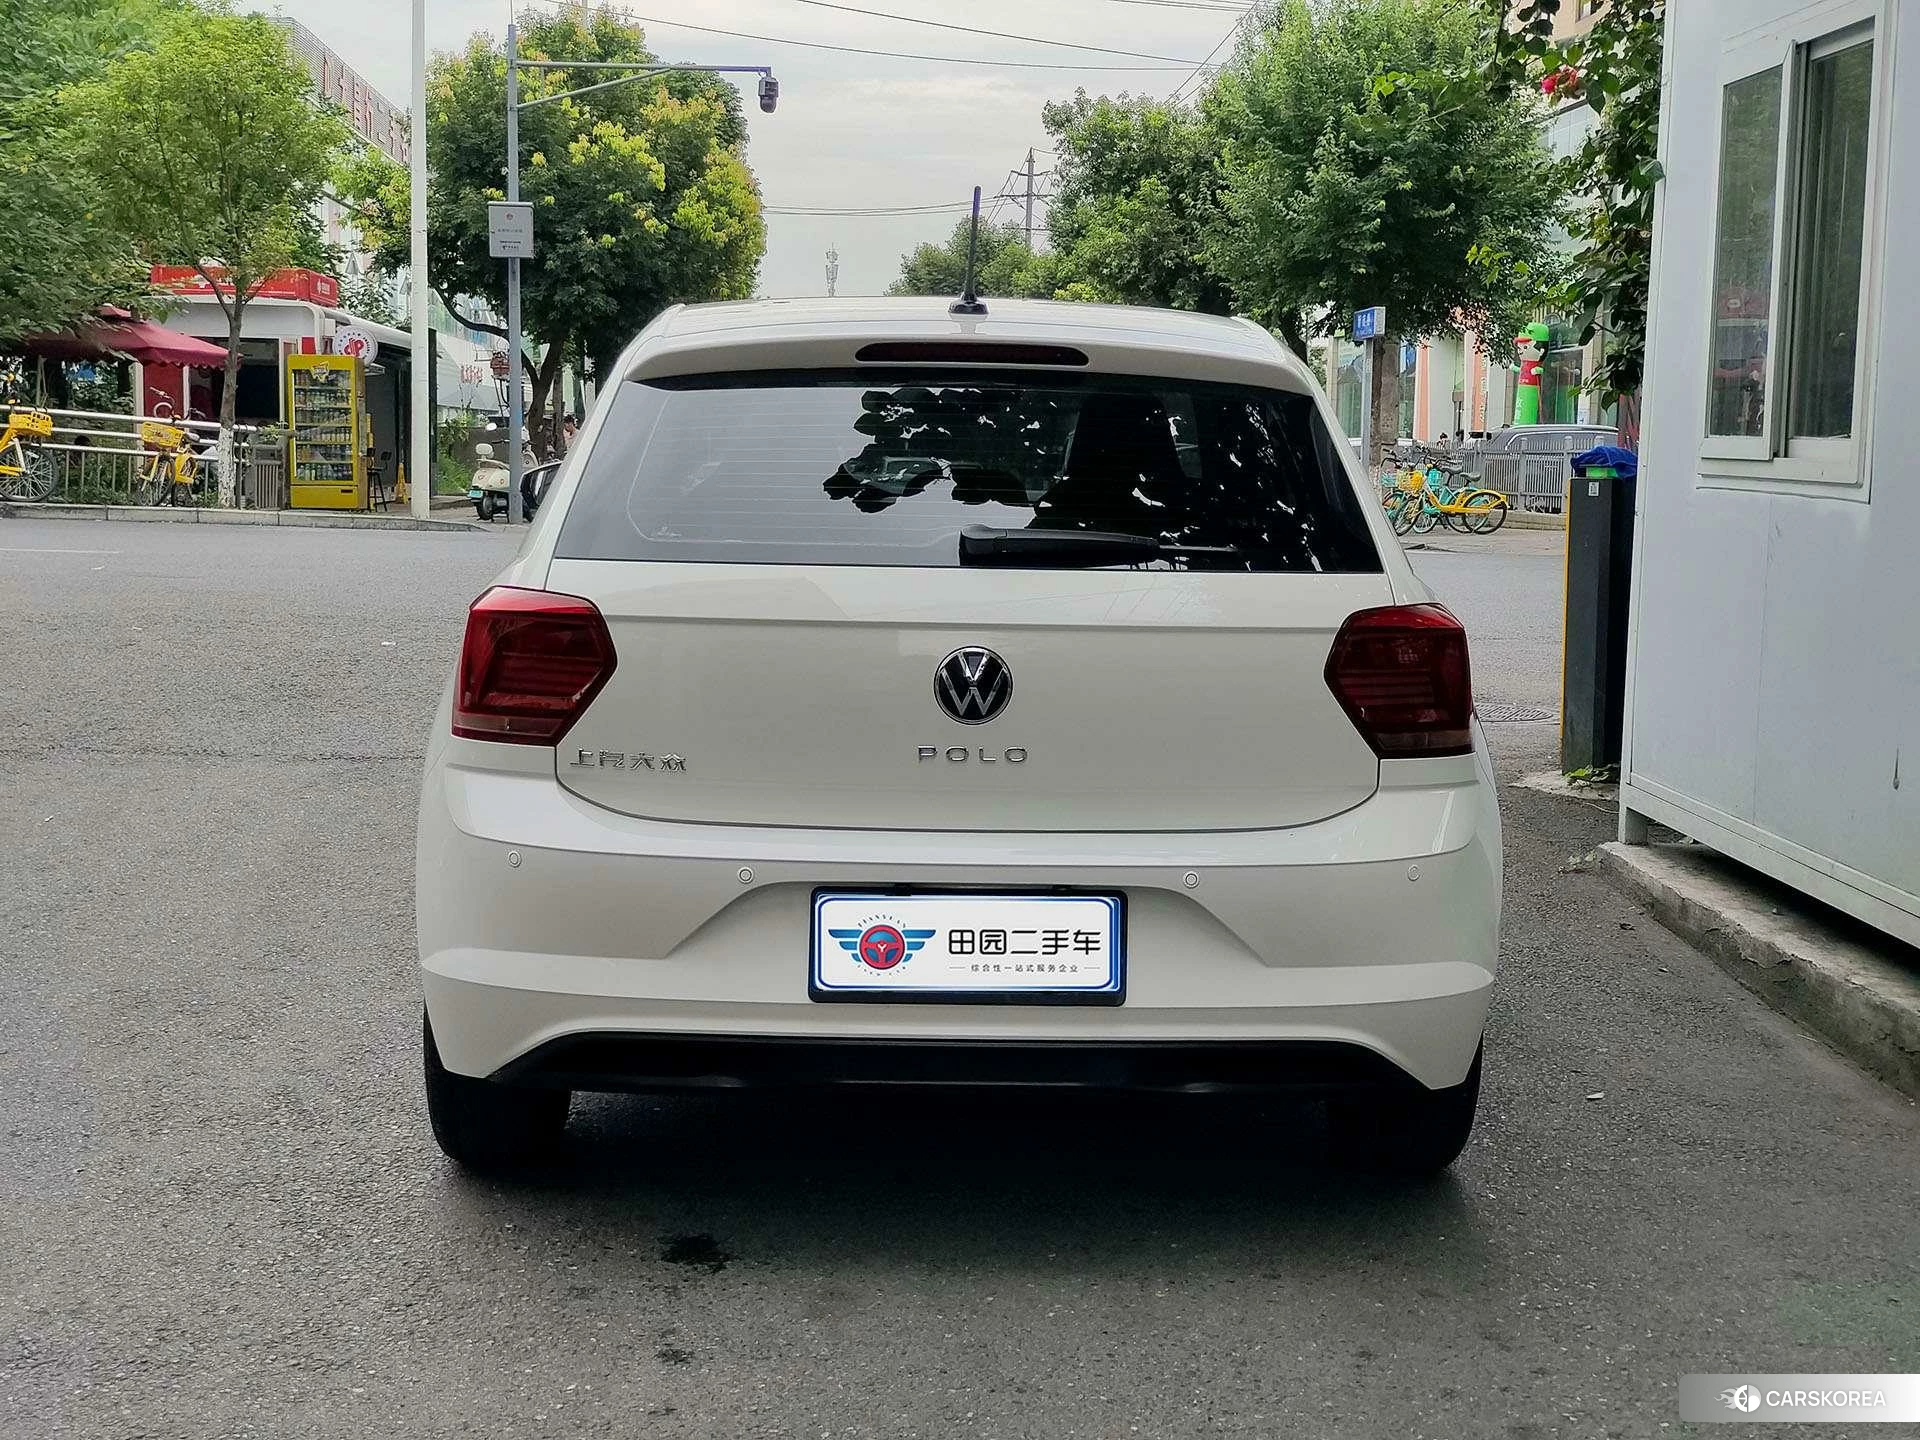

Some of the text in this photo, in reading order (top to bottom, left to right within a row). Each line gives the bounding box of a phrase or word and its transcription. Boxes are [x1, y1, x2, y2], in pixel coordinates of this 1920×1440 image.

[569, 748, 687, 771] 上汽大众
[917, 745, 1028, 763] POLO
[949, 929, 1101, 955] 田园二手车
[971, 963, 1079, 973] 综合性一站式服务企业
